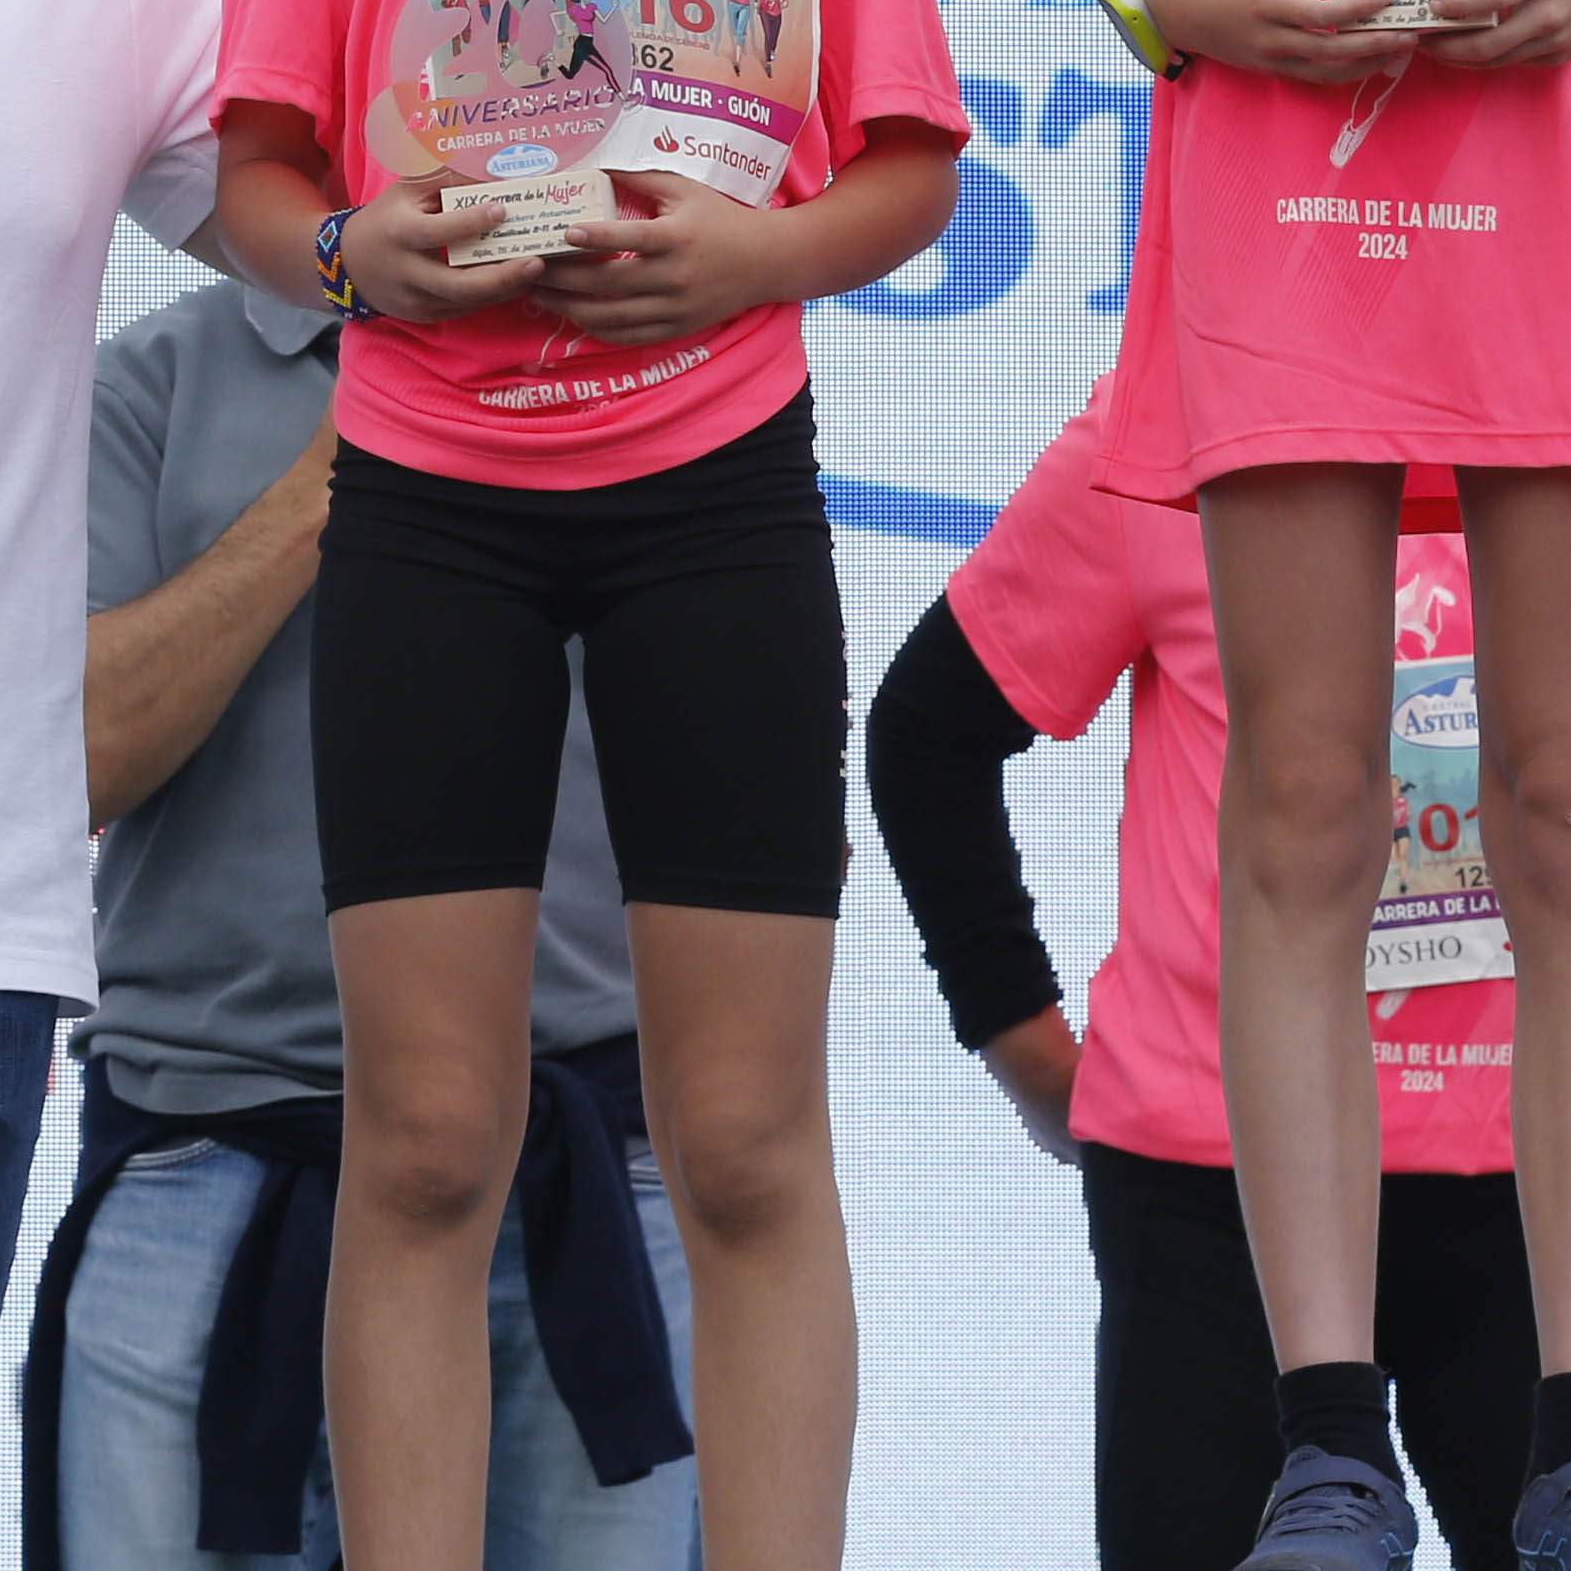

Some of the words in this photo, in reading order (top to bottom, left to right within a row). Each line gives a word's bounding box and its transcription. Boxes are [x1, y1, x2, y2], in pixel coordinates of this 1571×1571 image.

[632, 42, 674, 72] 62
[406, 86, 616, 133] ANIVERSARIO
[651, 79, 712, 109] MUJER
[728, 97, 771, 126] GIJÓN
[437, 131, 504, 152] CARRERA
[509, 127, 528, 143] DE
[532, 125, 551, 139] LA
[556, 118, 606, 137] MUJER
[492, 156, 550, 173] ASTURIANA
[683, 135, 772, 182] Santander
[545, 181, 587, 206] Mujer
[1275, 198, 1360, 226] CARRERA
[1365, 200, 1391, 227] DE
[1397, 201, 1423, 229] LA
[1428, 203, 1497, 231] MUJER
[1358, 233, 1409, 260] 2024
[479, 381, 570, 410] CARRERA
[572, 380, 605, 401] DE
[607, 373, 637, 394] LA
[640, 345, 712, 386] MUJER
[1404, 709, 1478, 736] ASTUR
[1455, 866, 1492, 888] 12
[1373, 901, 1440, 923] ARRERA
[1444, 897, 1466, 916] DE
[1470, 895, 1491, 912] LA
[1407, 1043, 1431, 1066] DE
[1435, 1044, 1457, 1066] LA
[1400, 1069, 1444, 1092] 2024
